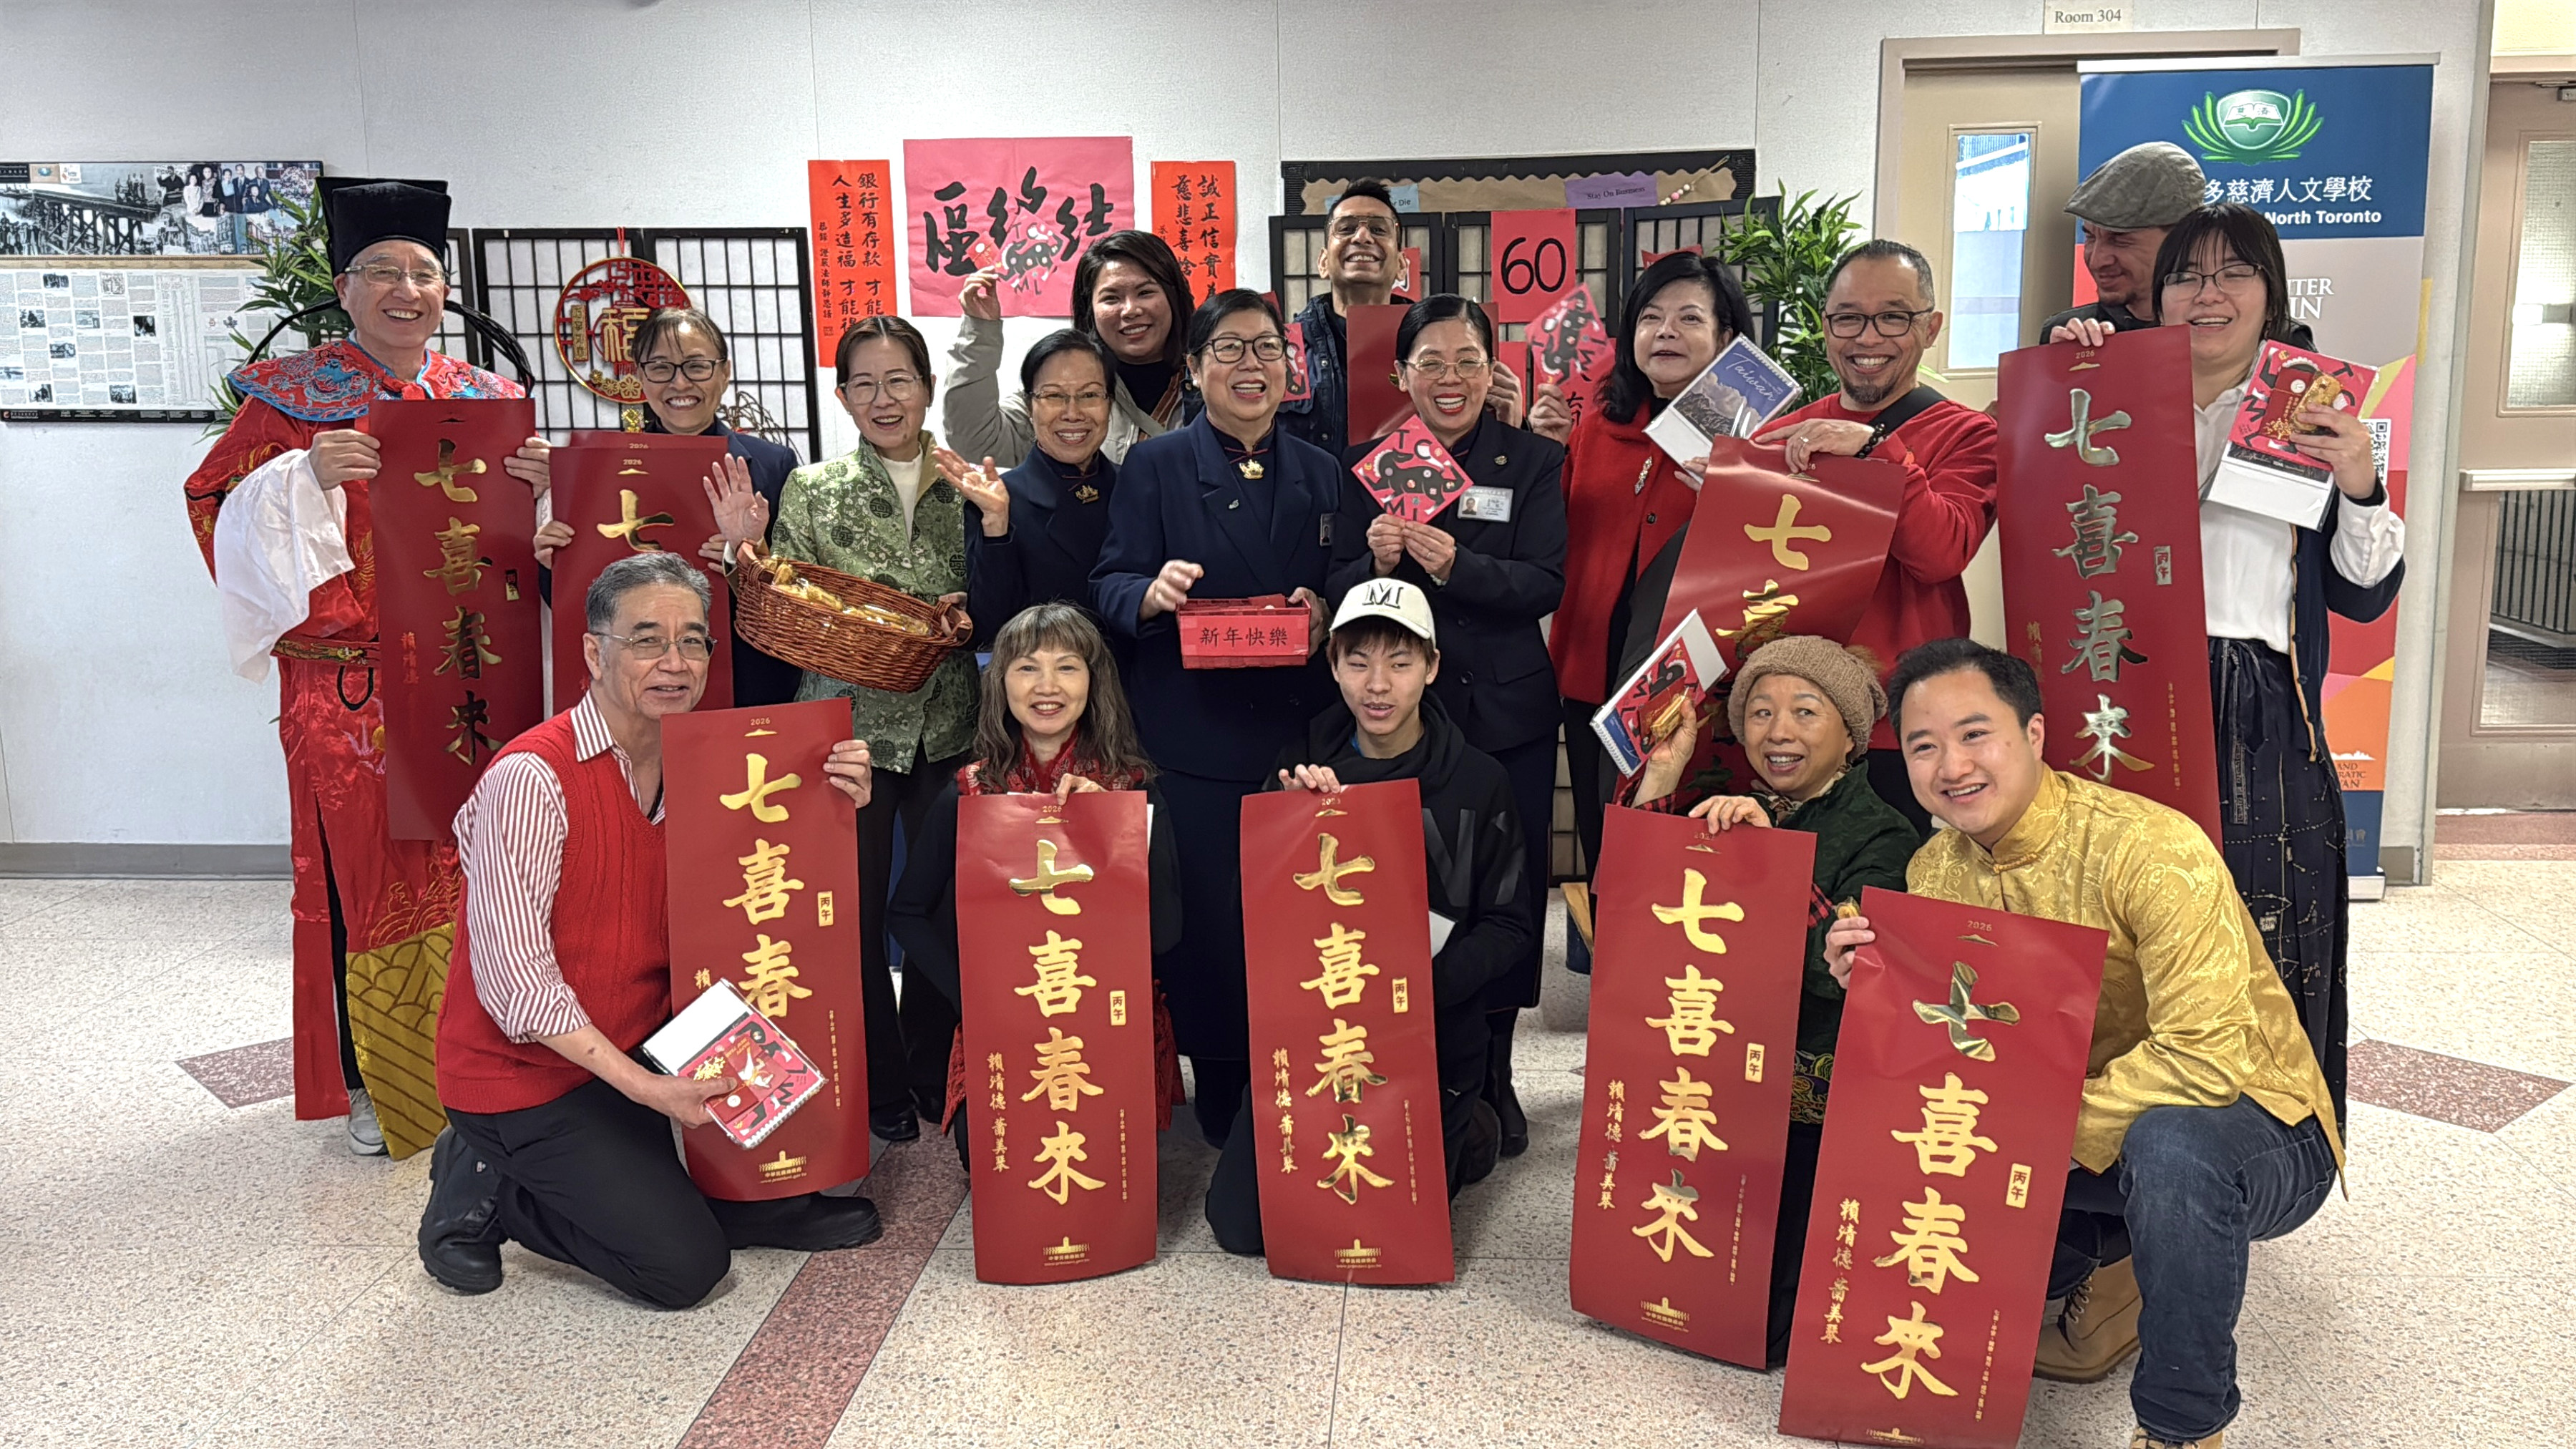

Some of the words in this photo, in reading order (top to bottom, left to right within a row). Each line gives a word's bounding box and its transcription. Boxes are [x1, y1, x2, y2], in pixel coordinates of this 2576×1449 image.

[2054, 11, 2094, 23] Room
[2097, 9, 2122, 22] 304
[1171, 175, 1197, 276] 慈悲喜捨
[2264, 211, 2311, 225] North
[2316, 210, 2381, 224] Toronto
[1501, 237, 1567, 295] 60
[2075, 349, 2095, 359] 2026
[1725, 352, 1776, 401] Taiwan
[596, 489, 675, 552] 七
[414, 438, 505, 766] 七喜春來
[1362, 582, 1405, 610] M
[2044, 388, 2155, 783] 七喜春來
[1199, 626, 1289, 648] 新年快樂
[750, 717, 771, 726] 2026
[1042, 804, 1063, 813] 2026
[719, 753, 813, 1018] 七喜春
[819, 896, 832, 922] 丙午
[1967, 919, 1993, 932] 2026
[693, 969, 712, 990] 賴
[1393, 980, 1407, 1010] 丙午
[1008, 839, 1107, 1205] 七喜春來
[1111, 994, 1125, 1022] 丙午
[1293, 832, 1395, 1205] 七喜春來
[986, 1051, 1007, 1111] 賴清德
[1631, 867, 1745, 1262] 七喜春來
[1747, 1048, 1762, 1078] 丙午
[1604, 1079, 1626, 1143] 賴清德
[1861, 961, 2020, 1398] 七喜春來
[2008, 1168, 2030, 1203] 丙午
[1832, 1198, 1860, 1270] 賴清德
